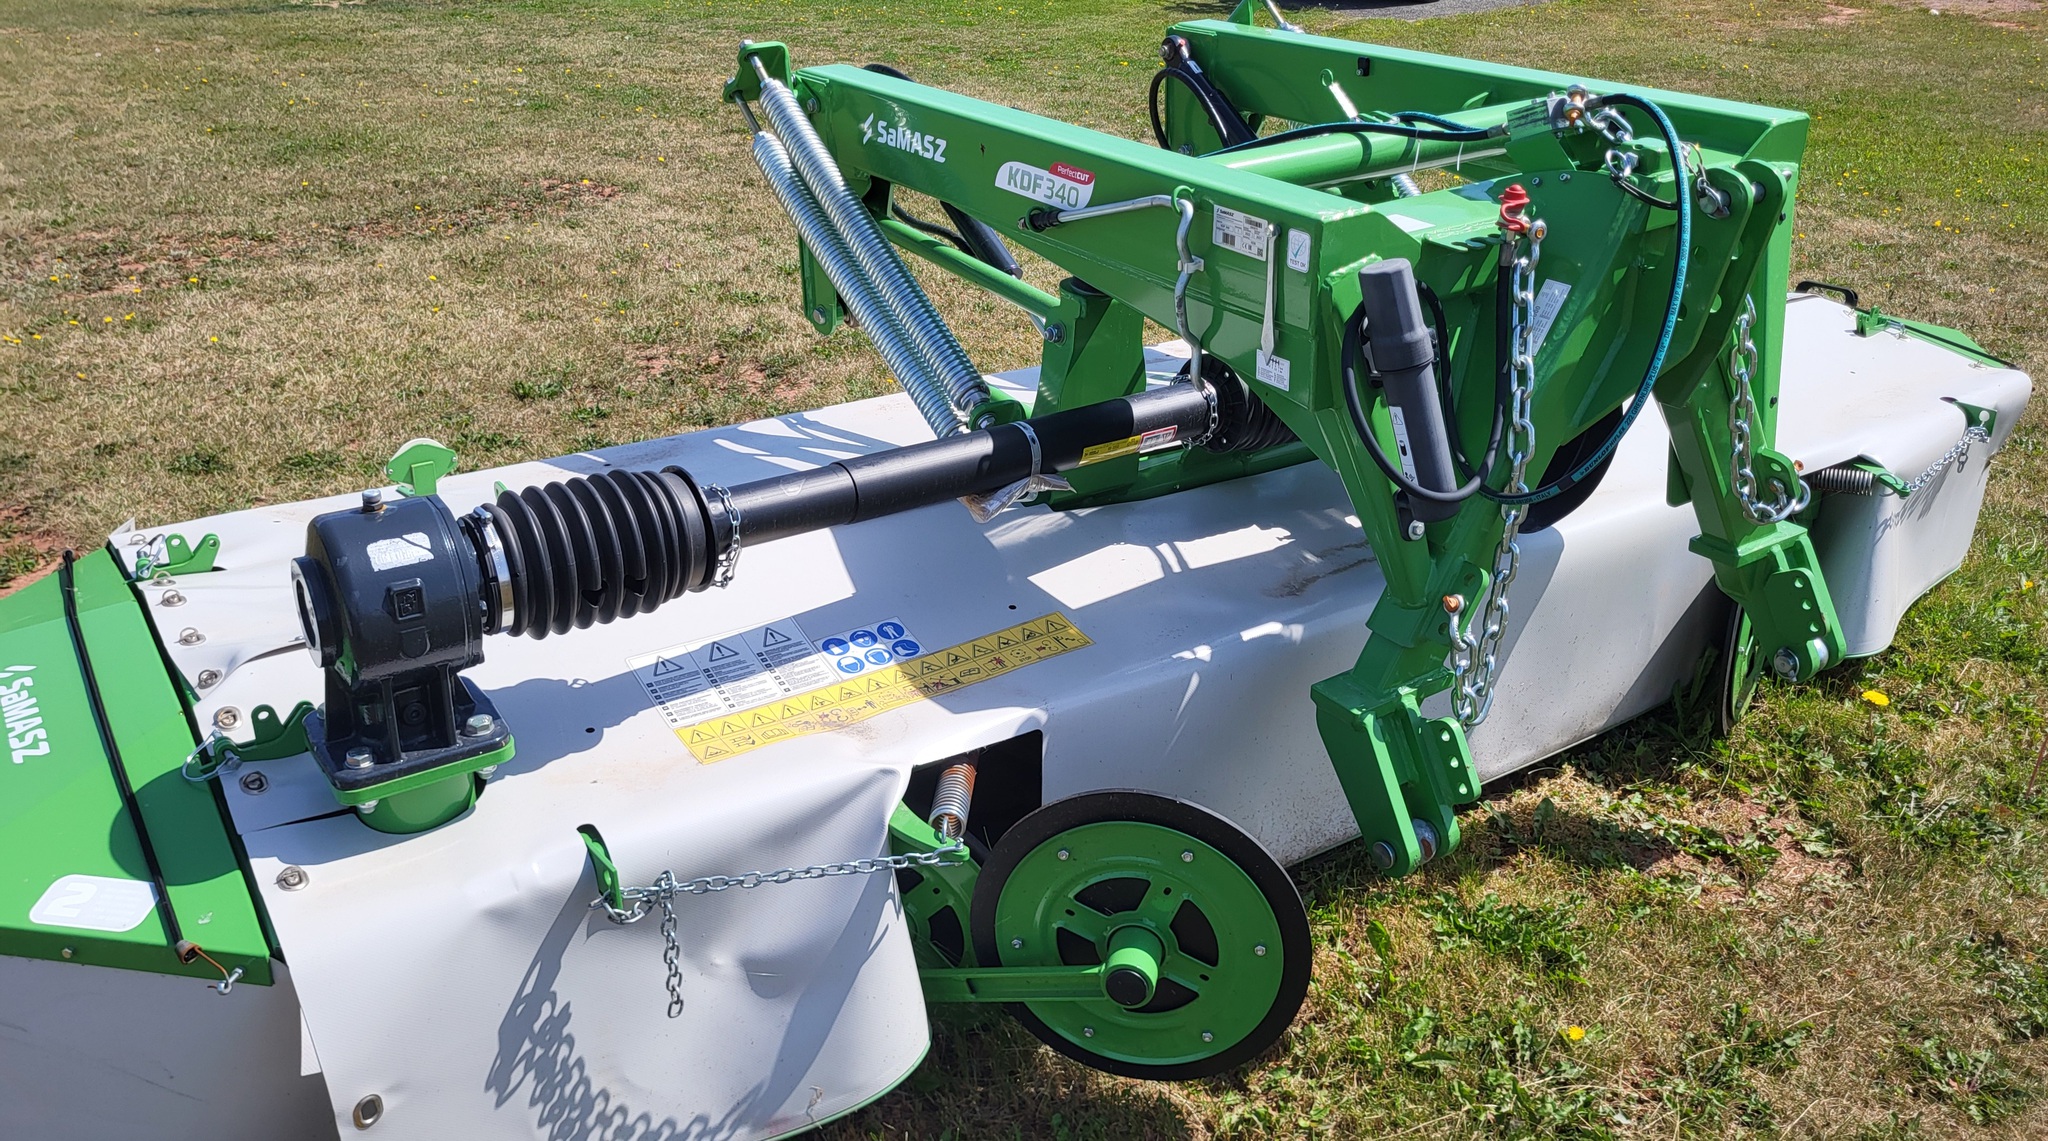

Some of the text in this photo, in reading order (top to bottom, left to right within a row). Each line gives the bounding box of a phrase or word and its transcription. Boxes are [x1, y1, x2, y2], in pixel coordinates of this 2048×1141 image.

[877, 120, 947, 163] SaMASZ
[1057, 165, 1090, 182] PerfectCUT
[1290, 258, 1300, 267] TEST
[1624, 414, 1634, 426] 222
[1630, 382, 1652, 415] GREENLINE
[1648, 365, 1658, 381] PLUS
[1536, 490, 1552, 501] ITALY
[0, 677, 51, 764] SaMASZ
[42, 882, 98, 918] 2
